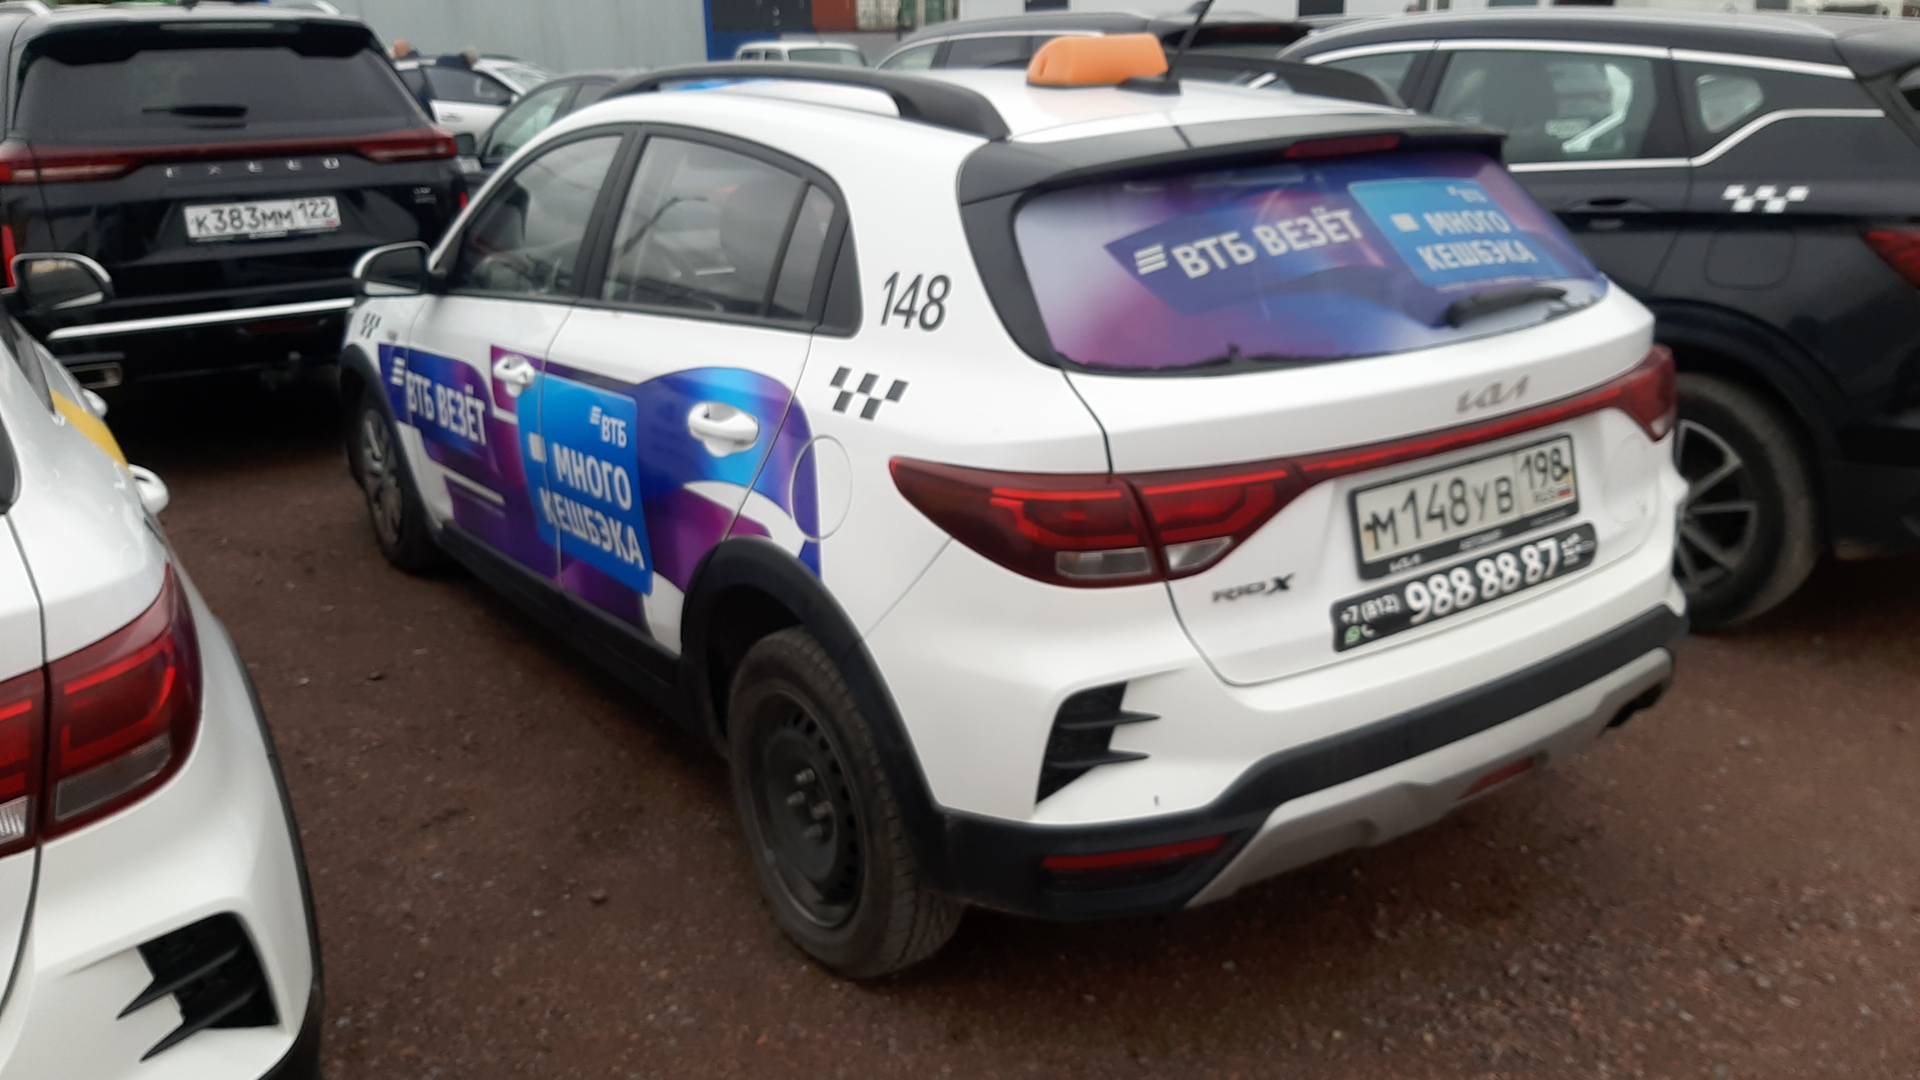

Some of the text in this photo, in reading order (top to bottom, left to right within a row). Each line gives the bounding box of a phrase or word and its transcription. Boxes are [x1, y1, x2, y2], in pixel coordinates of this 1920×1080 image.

[298, 201, 332, 219] 122
[1423, 210, 1512, 237] МНОГО
[1171, 206, 1363, 279] ВТБ ВЕЗЁТ
[1415, 239, 1538, 272] КЕШБЭКА
[880, 271, 952, 332] 148
[406, 370, 486, 446] ВТБ ВЕЗЁТ
[601, 414, 628, 449] ВТБ
[552, 442, 633, 512] МНОГО
[1519, 446, 1566, 490] 198
[538, 486, 646, 571] КЕШБЭКА
[1340, 606, 1360, 624] +7
[1361, 594, 1400, 623] (812)
[1404, 567, 1476, 625] 988
[1475, 552, 1521, 599] 88
[1519, 538, 1558, 584] 87
